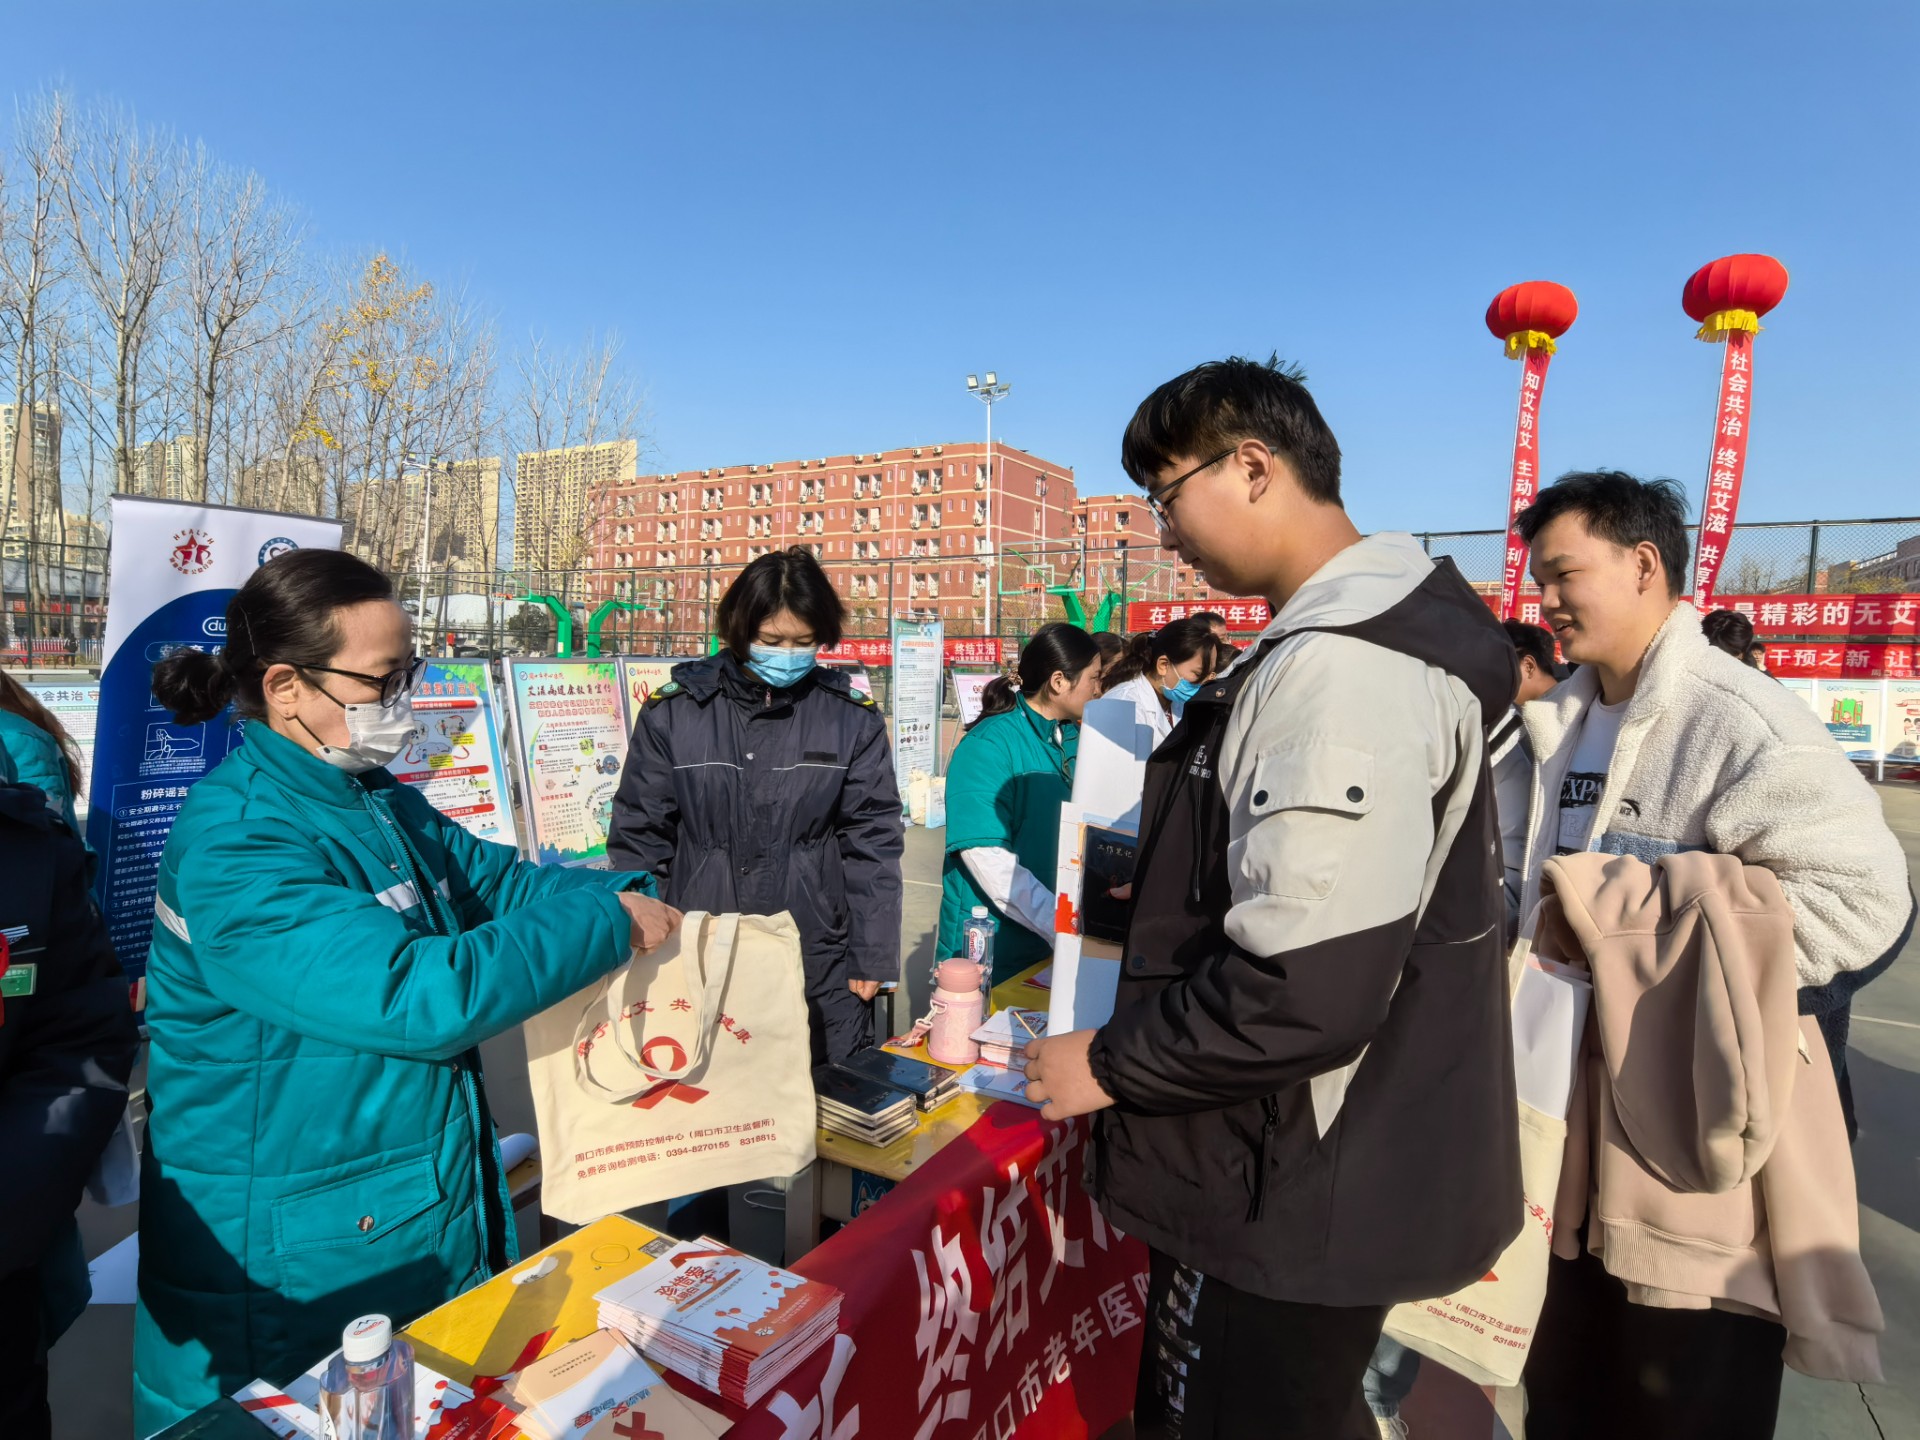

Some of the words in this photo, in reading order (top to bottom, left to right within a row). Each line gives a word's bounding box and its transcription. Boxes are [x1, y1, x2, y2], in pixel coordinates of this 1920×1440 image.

[1721, 350, 1748, 437] 社会共治
[1519, 370, 1540, 450] 知艾防艾
[1705, 446, 1738, 535] 终结艾滋
[173, 528, 214, 545] HEALTH
[1769, 650, 1871, 667] 干预之新
[140, 786, 188, 801] 粉碎谣言
[739, 1133, 777, 1147] 8318815
[1492, 1334, 1527, 1351] 8318815
